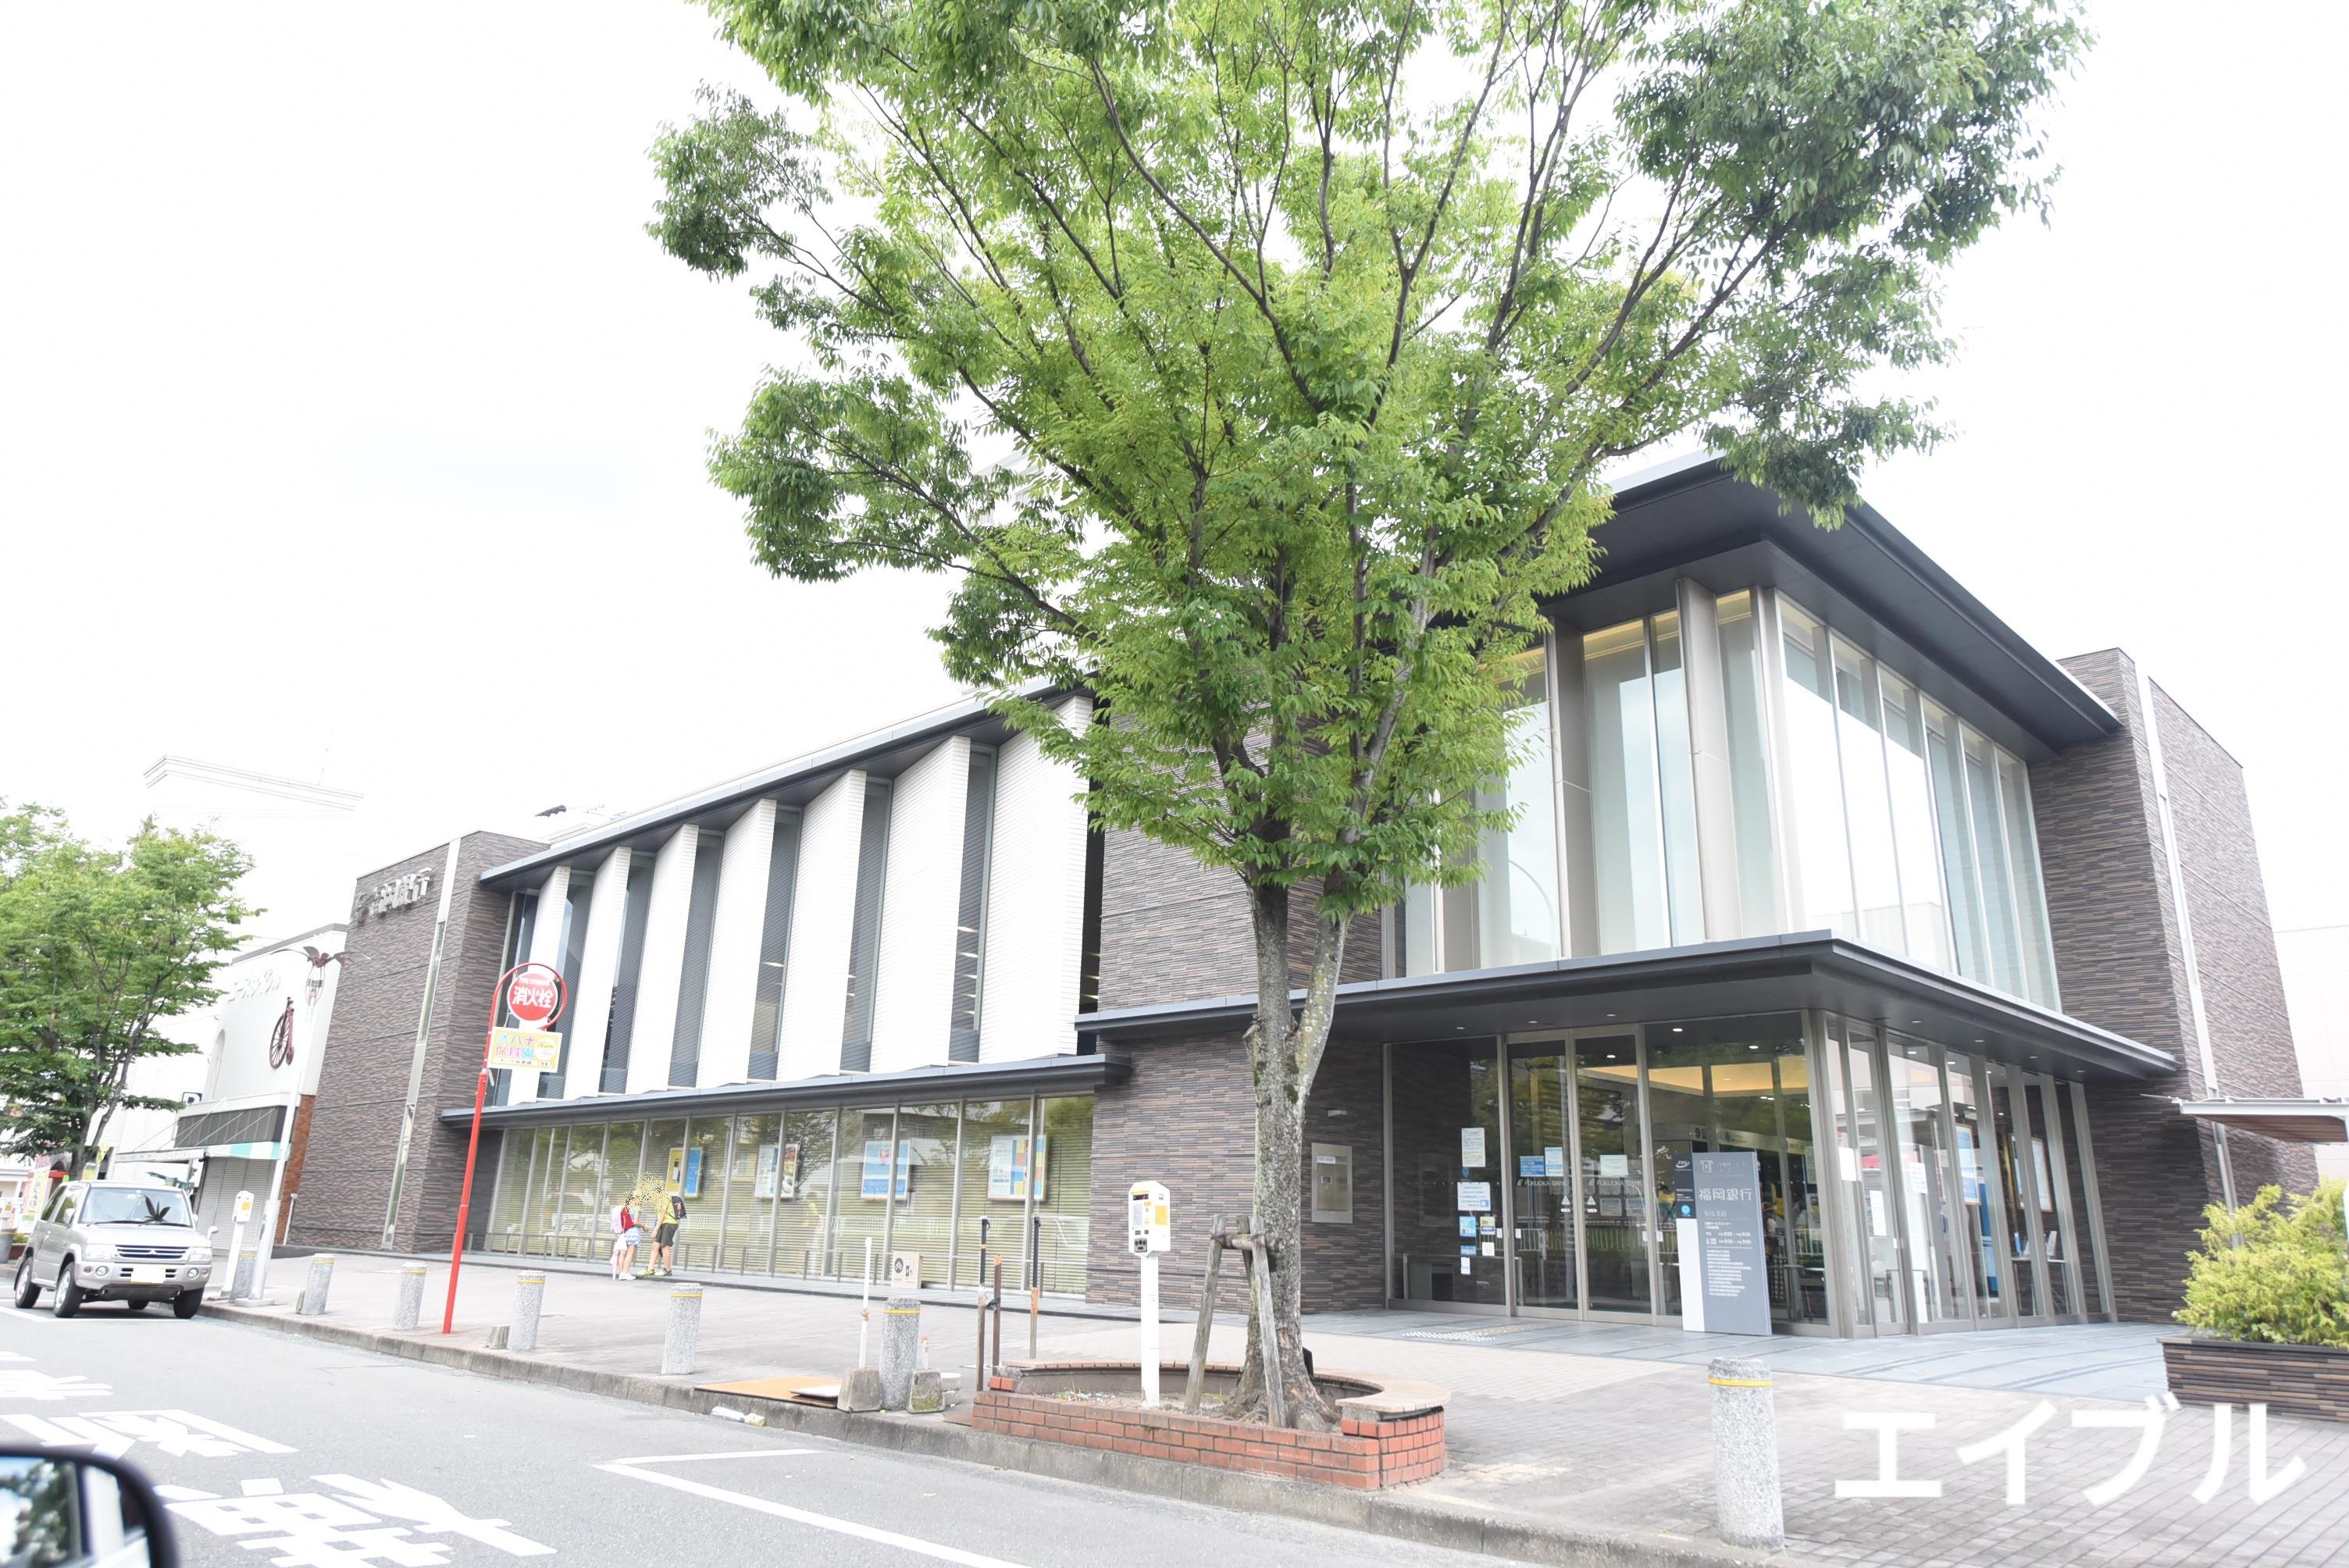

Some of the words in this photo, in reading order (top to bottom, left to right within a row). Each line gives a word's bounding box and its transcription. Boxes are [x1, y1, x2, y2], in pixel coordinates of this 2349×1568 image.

[512, 985, 553, 1009] 消火栓
[1698, 1188, 1752, 1201] 福岡銀行
